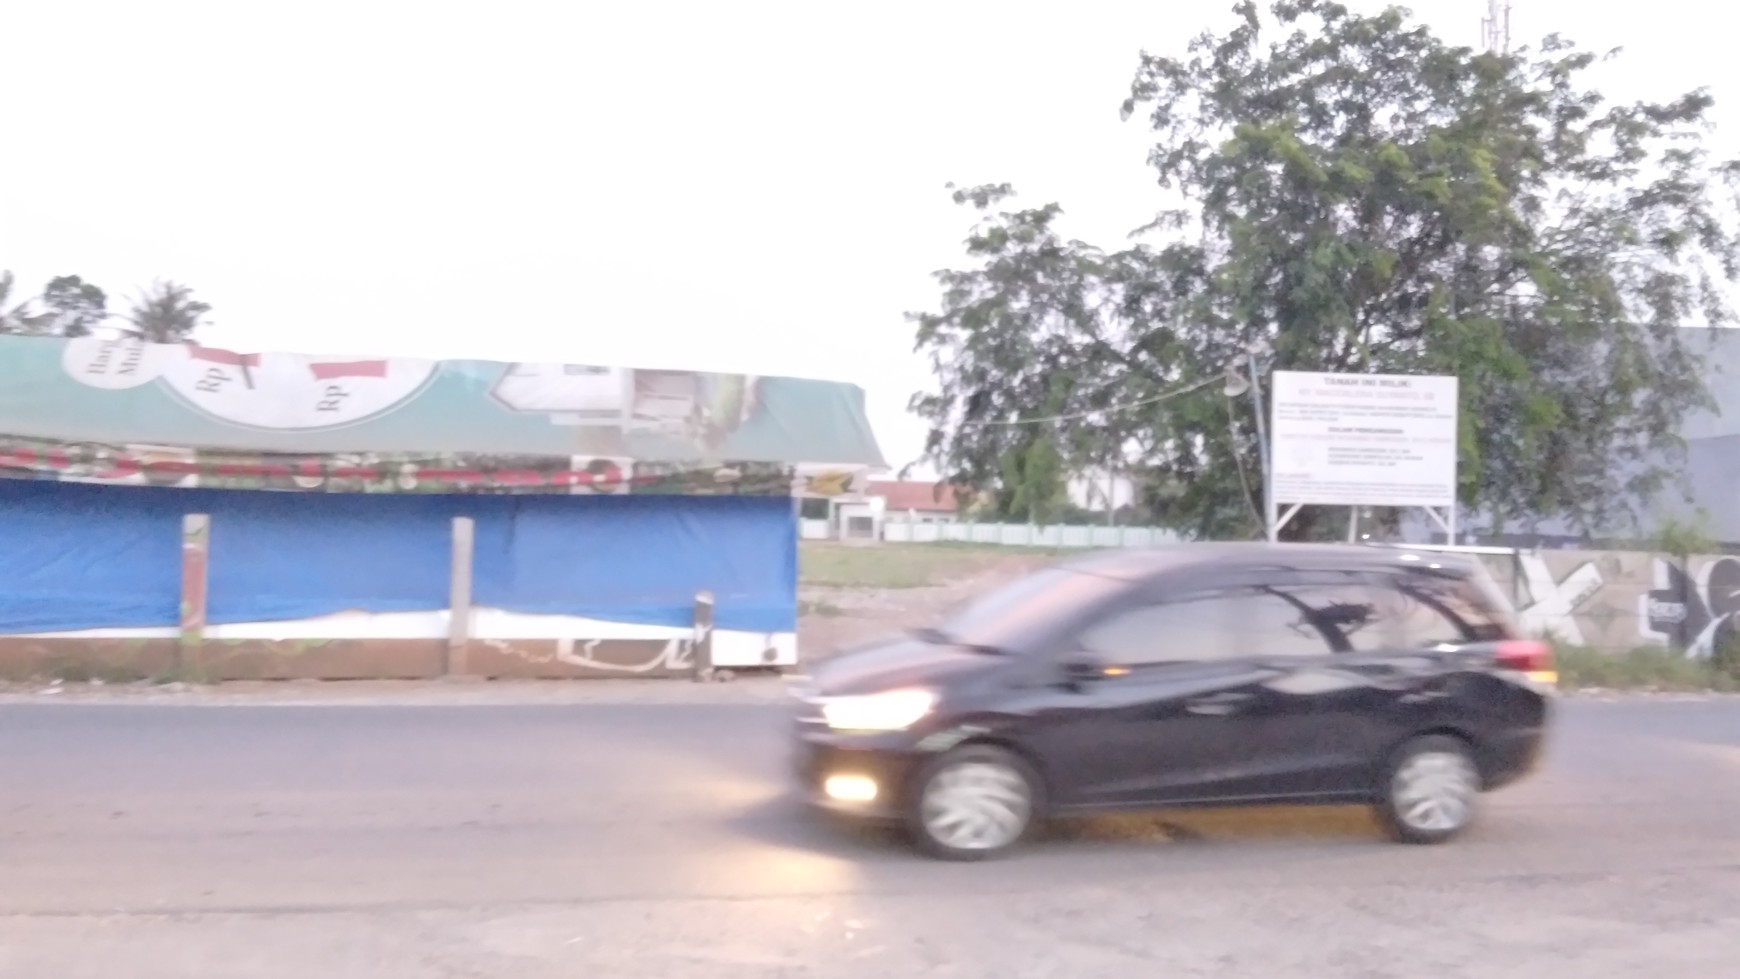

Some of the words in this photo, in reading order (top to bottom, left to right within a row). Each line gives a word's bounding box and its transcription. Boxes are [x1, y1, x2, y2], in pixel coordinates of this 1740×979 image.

[195, 367, 233, 393] Rp
[1323, 377, 1359, 386] TANAH
[1361, 379, 1376, 387] INI
[315, 385, 350, 411] Rp
